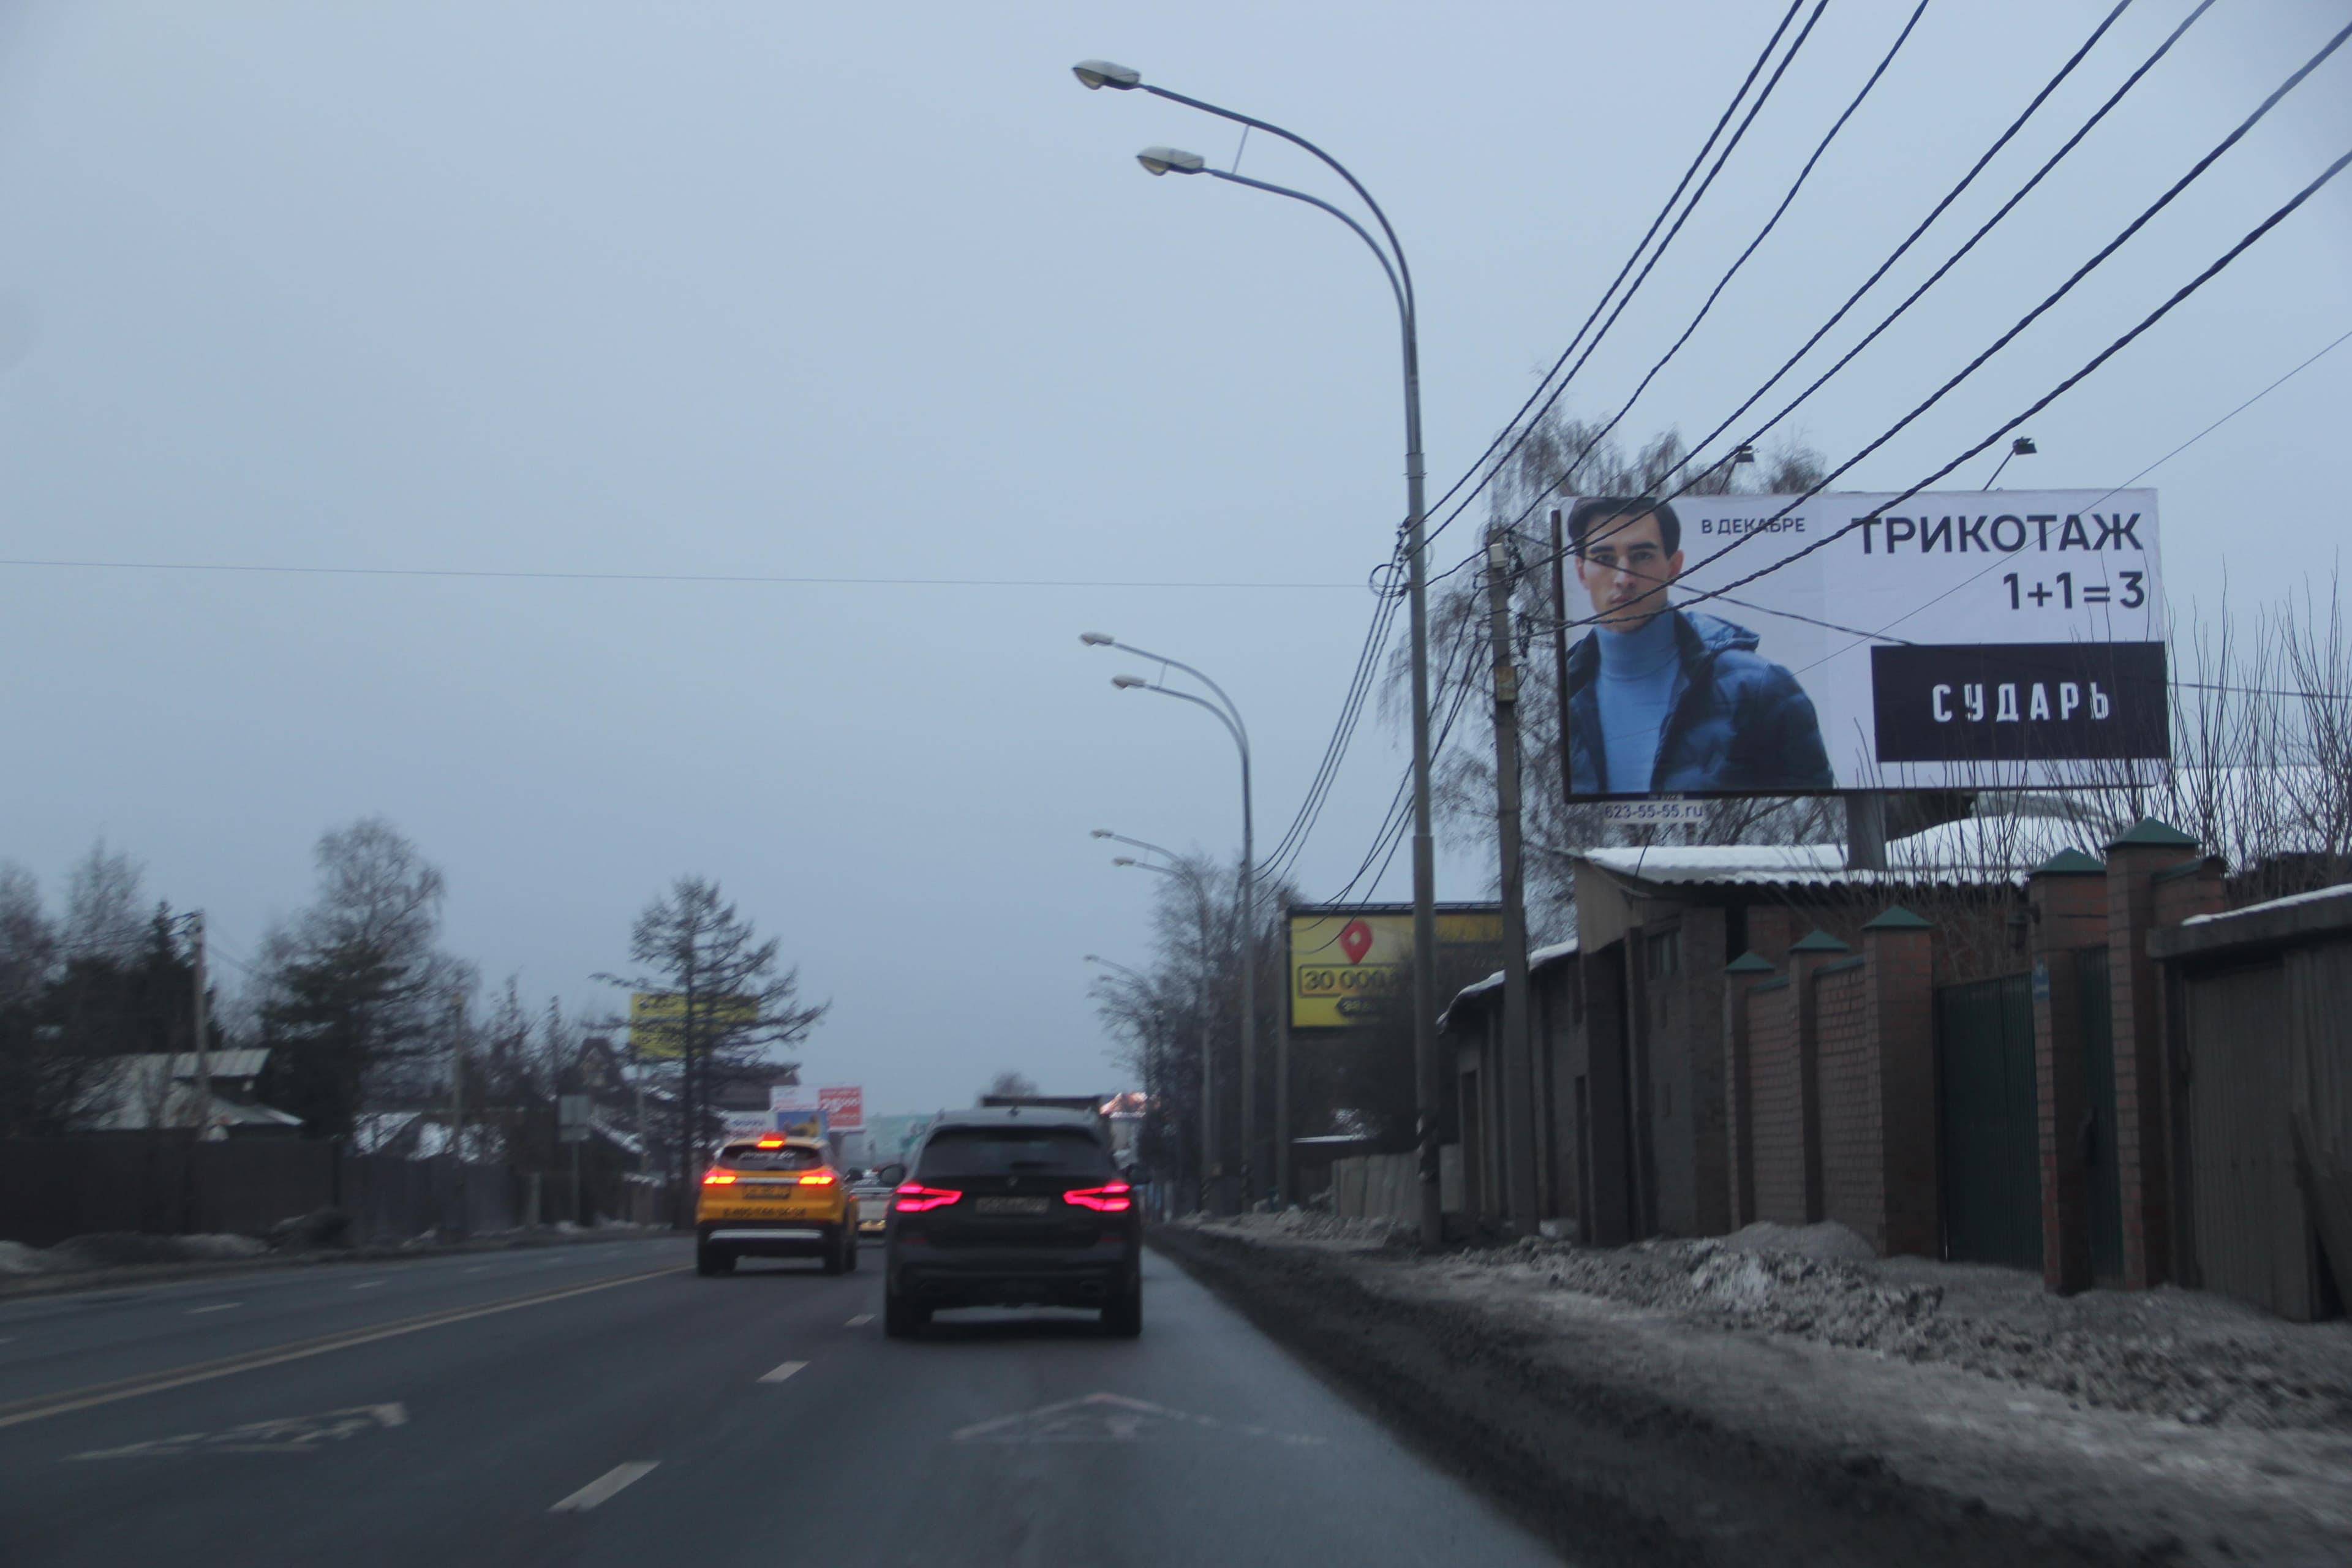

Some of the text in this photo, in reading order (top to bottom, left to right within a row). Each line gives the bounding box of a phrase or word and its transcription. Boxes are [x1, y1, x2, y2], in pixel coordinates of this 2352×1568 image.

[1702, 518, 1805, 535] В ДЕКАБРЕ
[1851, 513, 2143, 554] ТРИКОТАЖ
[1932, 682, 2109, 722] СУДАРЬ
[1605, 804, 1703, 818] 623-55-55.ru
